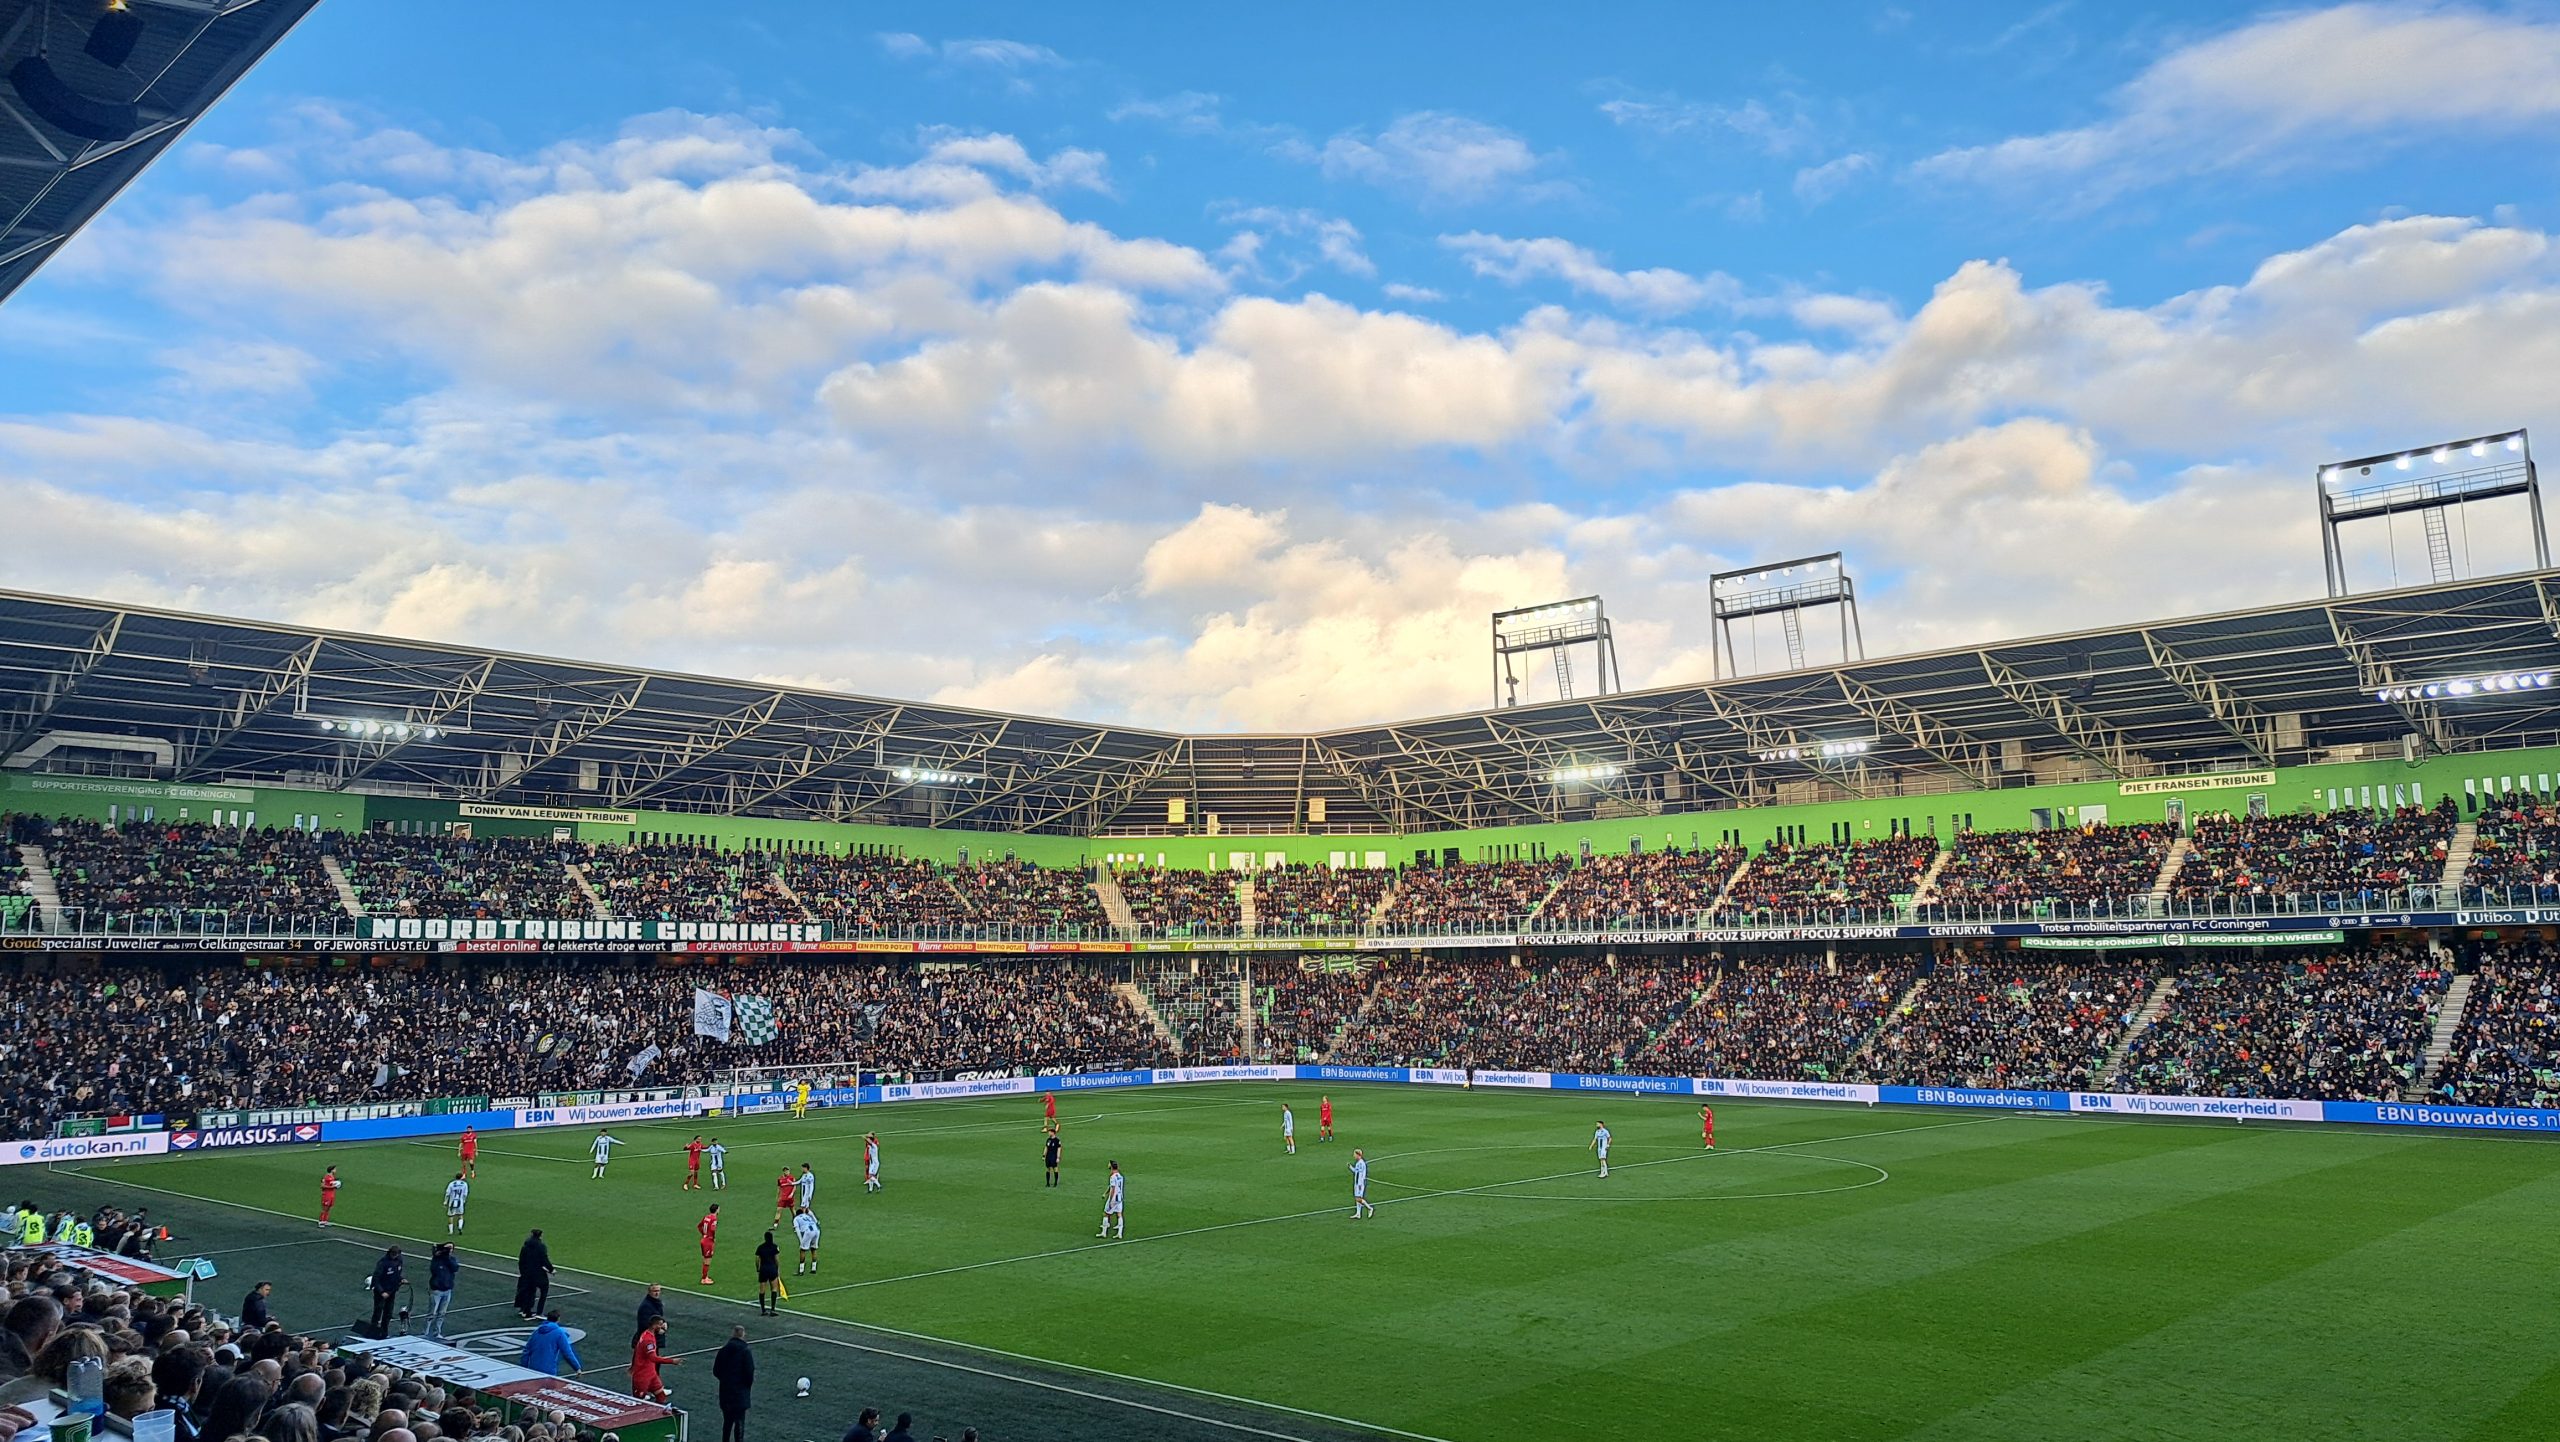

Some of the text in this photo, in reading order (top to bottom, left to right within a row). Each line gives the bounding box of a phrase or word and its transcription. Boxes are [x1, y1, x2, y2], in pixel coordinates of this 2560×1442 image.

[32, 781, 236, 799] SUPPORTERSVERENIGING FC GRONINGEN
[2125, 774, 2268, 793] PIET FRANSEN TRIBUNE
[468, 806, 630, 822] TONNY VAN LEEUWEN TRIBUNE
[2473, 911, 2516, 924] Utibo.
[371, 918, 822, 942] NOORDTRIBUNE GRONINGEN
[1928, 925, 1995, 936] CENTURY.NL
[2039, 918, 2270, 934] Trotse mobiliteitspartner van FC Groningen
[1524, 934, 1600, 945] FOCUZ SUPPORT
[1607, 932, 1689, 943] FOCUZ SUPPORT
[1702, 929, 1791, 942] FOCUZ SUPPORT
[1801, 927, 1898, 940] FOCUZ SUPPORT
[2189, 932, 2334, 944] SUPPORTERS ON WHEELS
[2, 937, 102, 951] Goudspecialist
[105, 938, 160, 950] Juwelier
[199, 938, 285, 951] Gelkingestraat
[287, 940, 302, 950] 34
[314, 941, 430, 951] OFJEWORSTLUST.EU
[466, 940, 537, 951] bestel online
[542, 940, 666, 952] de lekkerste droge worst
[696, 941, 783, 951] OFJEWORSTLUST.EU
[2025, 937, 2157, 947] ROLLYSIDE FC GRONINGEN
[955, 1066, 1010, 1082] GRUNN
[1158, 1070, 1176, 1080] EBN
[1182, 1067, 1278, 1080] Wij bouwen zekerheid in
[1321, 1068, 1338, 1077] EBN
[1415, 1070, 1434, 1080] EBN
[1441, 1071, 1453, 1082] Wij
[1484, 1073, 1526, 1084] zekerheid
[1527, 1074, 1535, 1084] in
[920, 1080, 1020, 1097] Wij bouwen zekerheid in
[1061, 1077, 1080, 1088] EBN
[1579, 1076, 1601, 1088] EBN
[1701, 1081, 1725, 1092] EBN
[888, 1086, 911, 1098] EBN
[1735, 1082, 1857, 1098] Wij bouwen zekerheid in
[1917, 1089, 1945, 1103] EBN
[538, 1093, 601, 1108] TEN BOER
[2081, 1095, 2111, 1108] EBN
[2127, 1097, 2293, 1116] Wij bouwen zekerheid in
[447, 1104, 482, 1115] LOCALS
[525, 1109, 555, 1123] EBN
[568, 1101, 702, 1122] Wij bouwen zekerheid in
[2376, 1106, 2414, 1122] EBN
[201, 1128, 291, 1148] AMASUS.nl
[40, 1137, 147, 1158] autokan.nl
